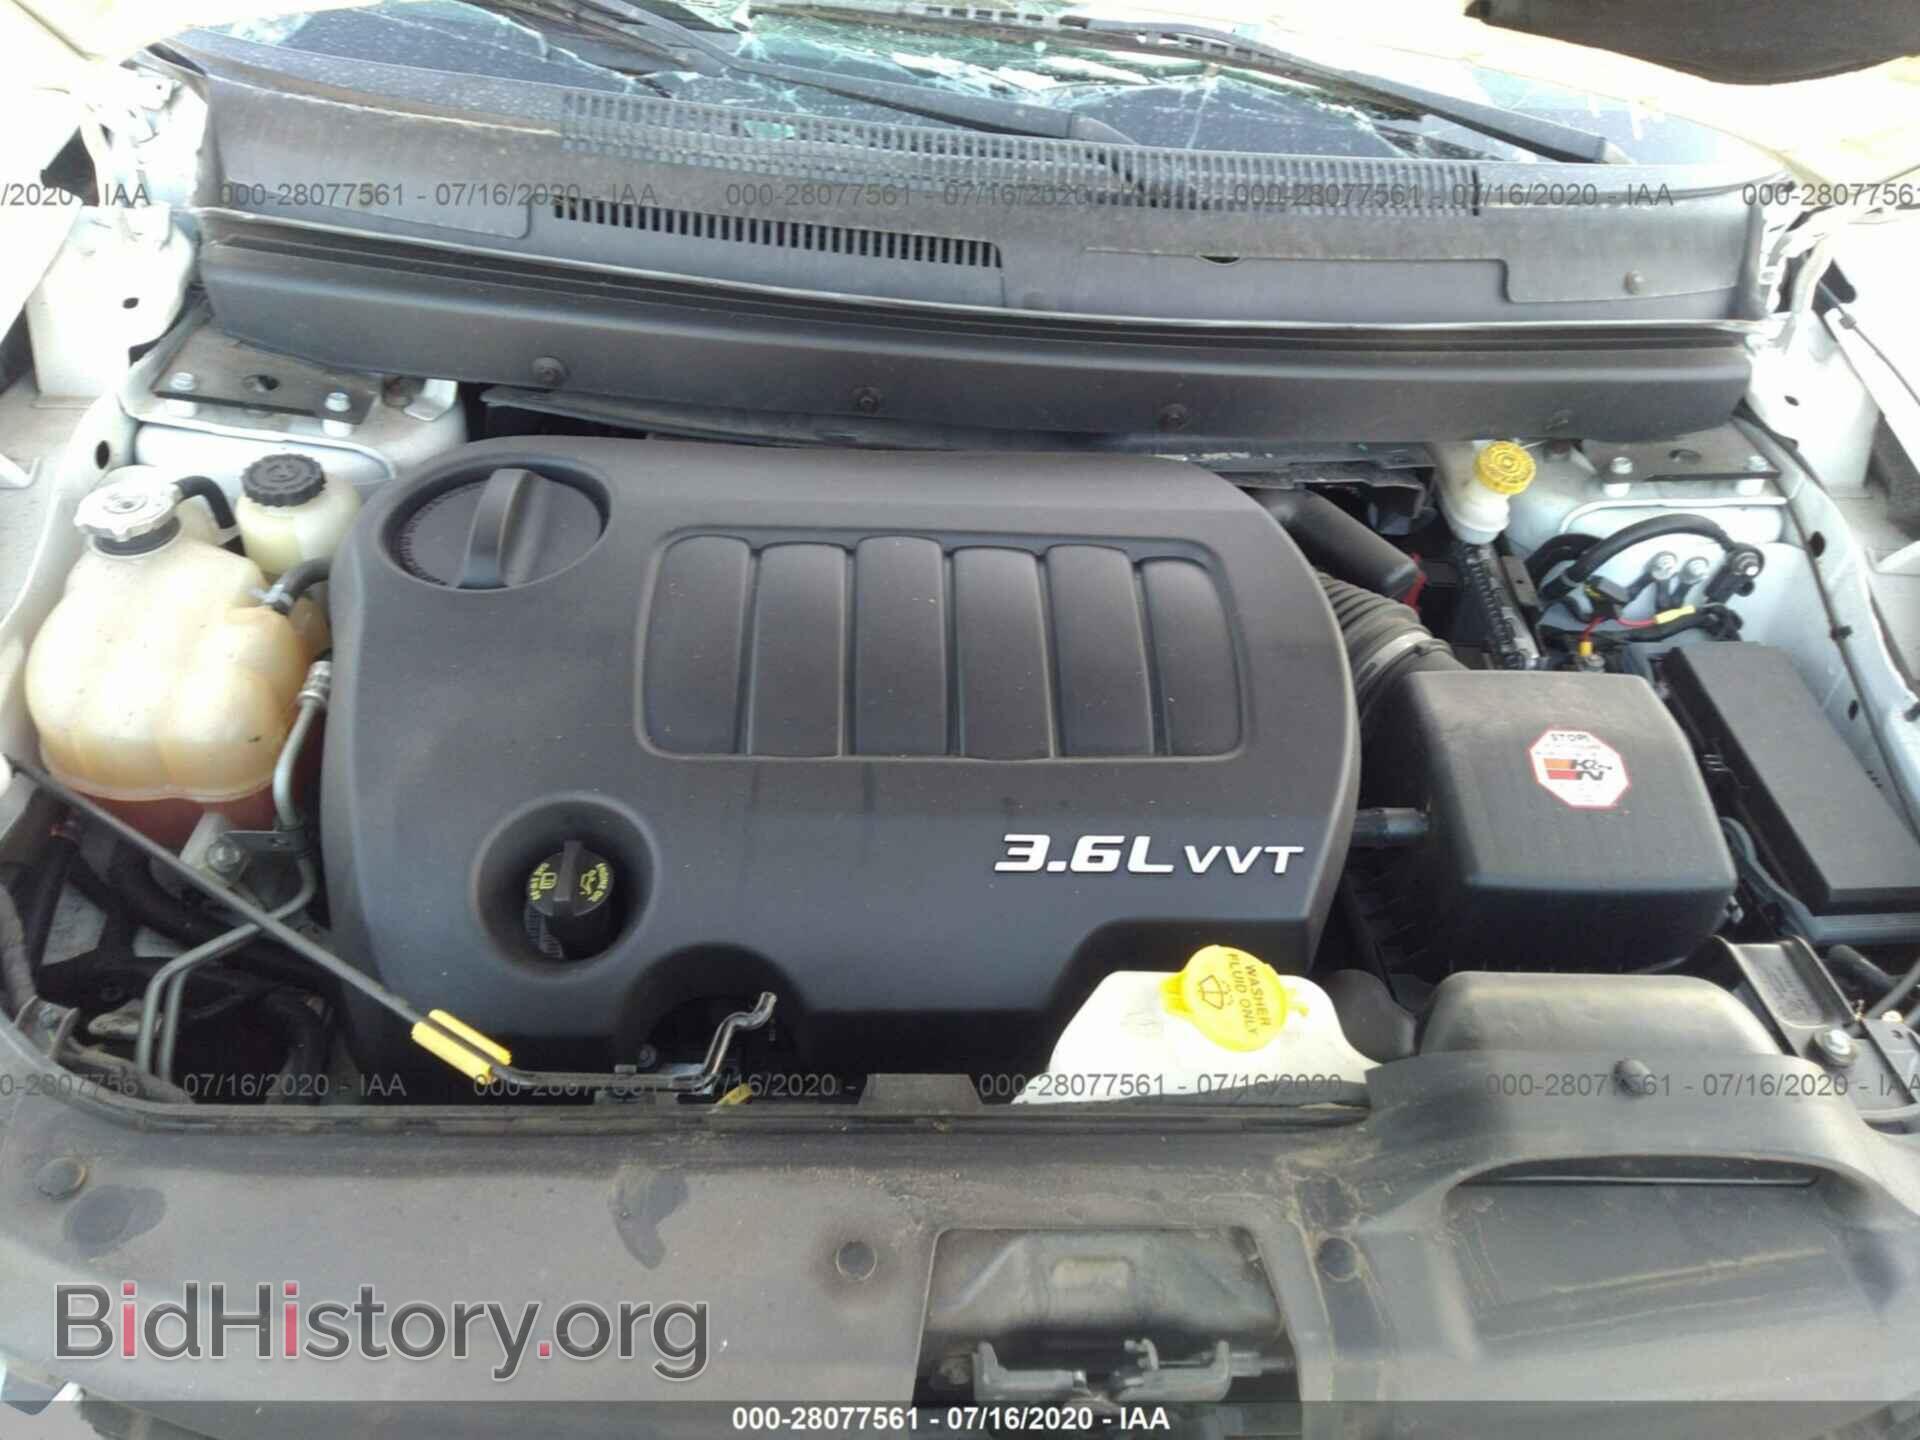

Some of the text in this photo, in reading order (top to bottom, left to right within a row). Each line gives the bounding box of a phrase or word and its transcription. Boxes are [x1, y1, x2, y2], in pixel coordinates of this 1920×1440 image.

[994, 834, 1304, 874] 3.6L VVT
[1227, 953, 1258, 1034] FLUID ONLY
[1245, 964, 1272, 1026] WASHER
